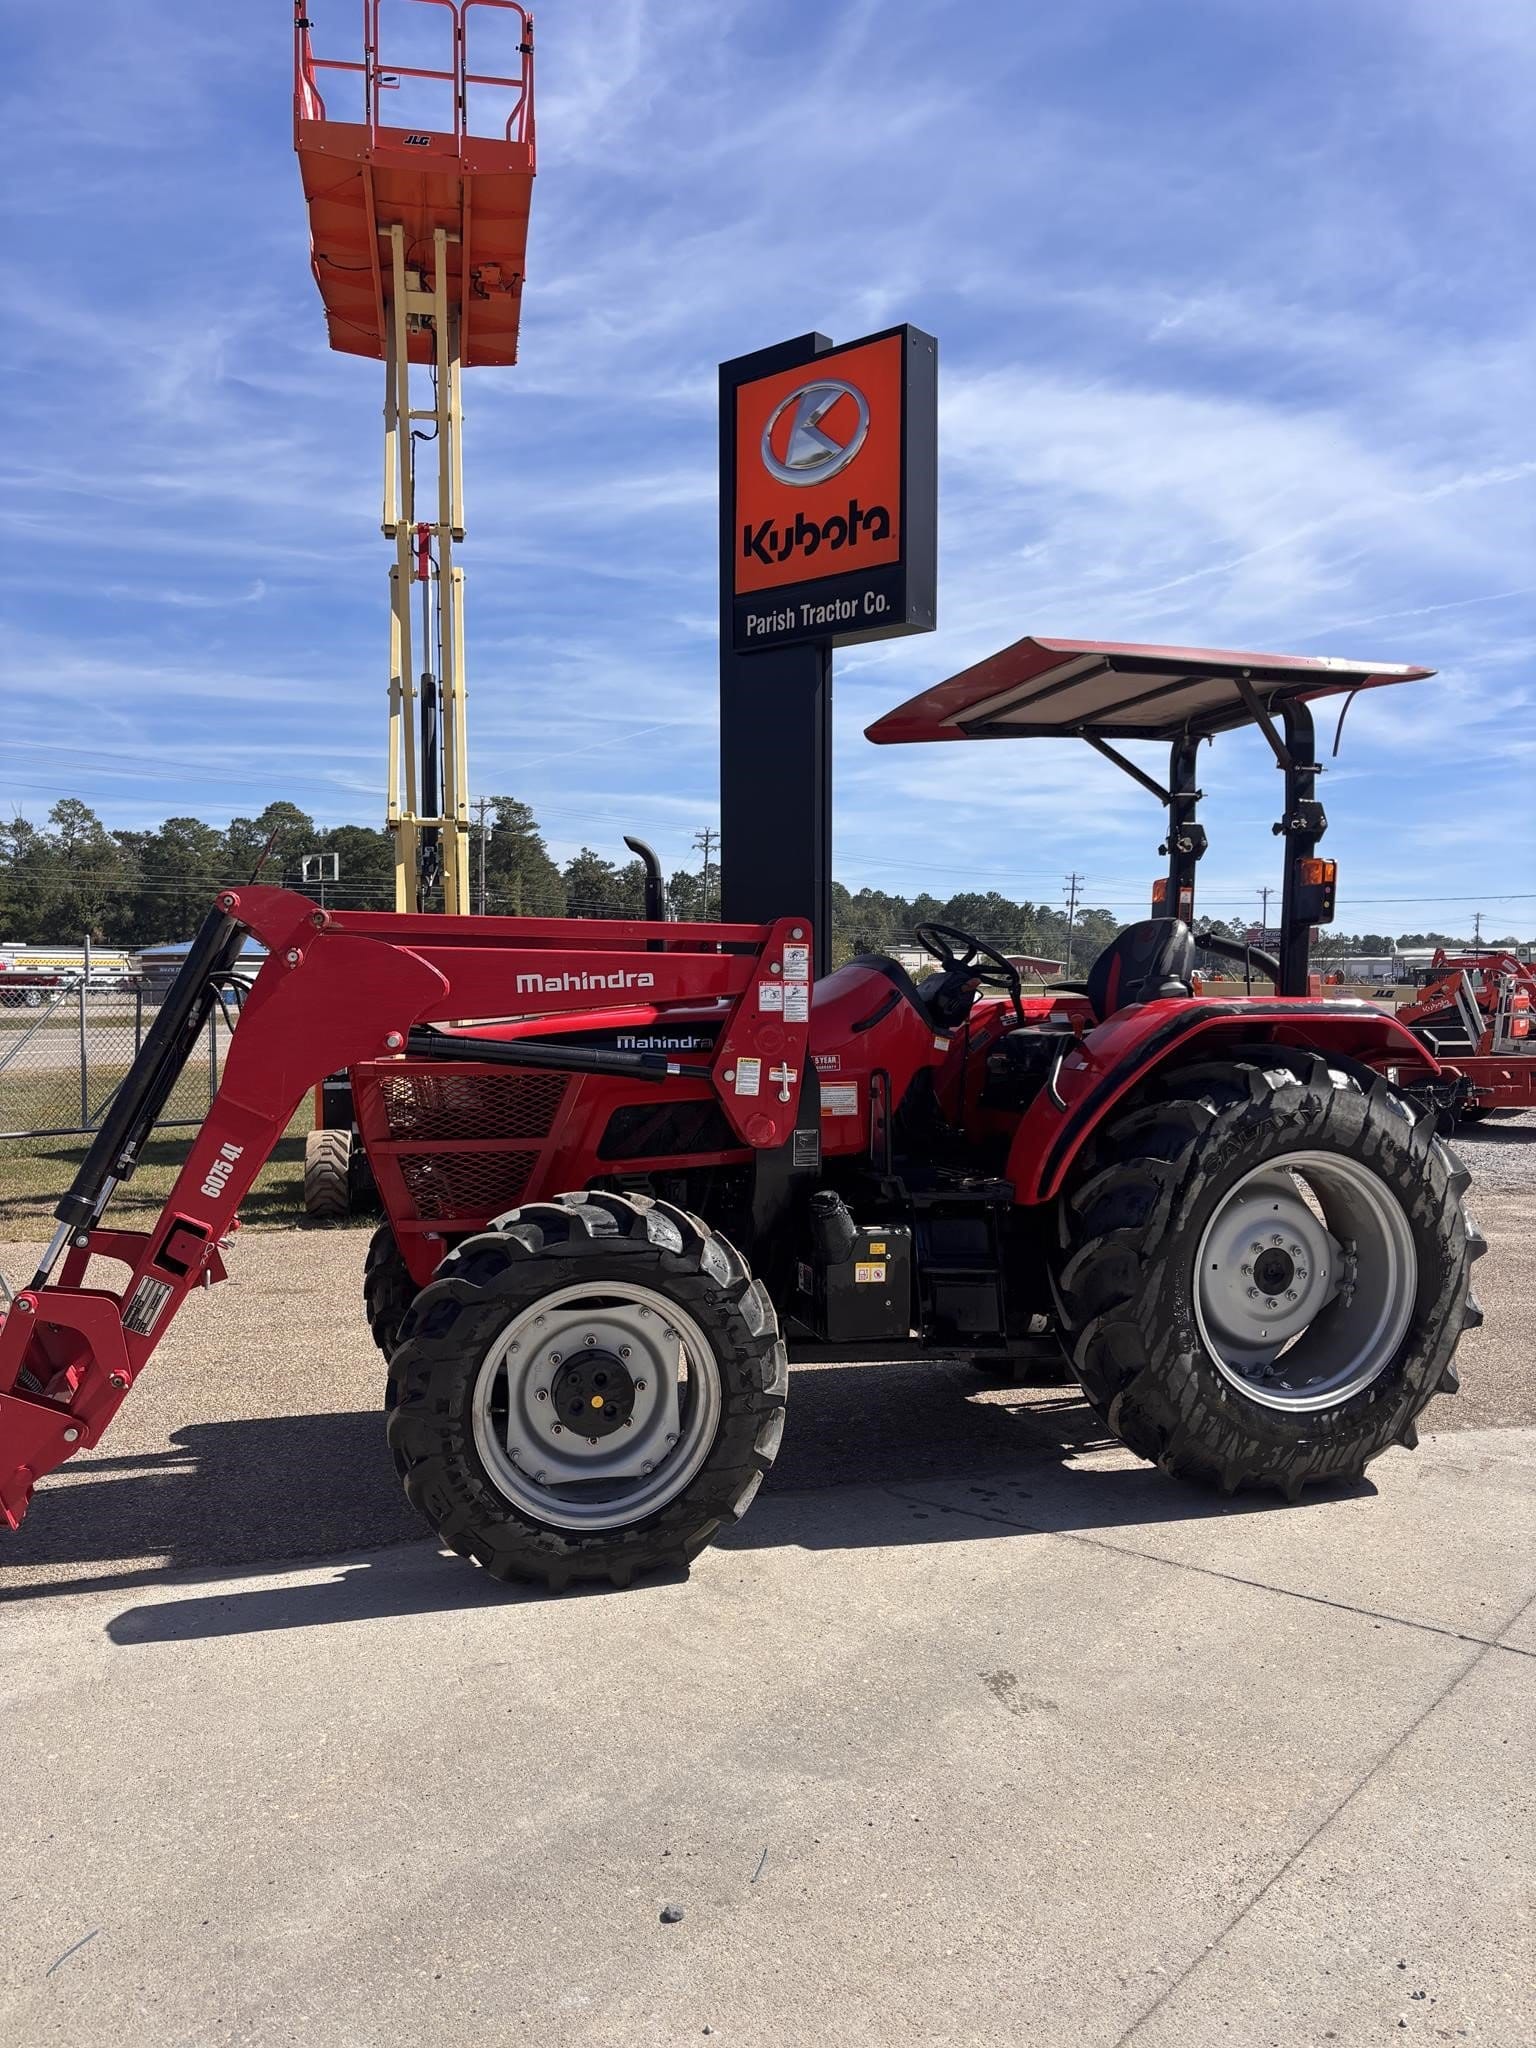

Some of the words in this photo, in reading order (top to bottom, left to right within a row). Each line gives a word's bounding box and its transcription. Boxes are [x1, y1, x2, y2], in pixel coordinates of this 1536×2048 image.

[404, 135, 430, 146] JLG
[743, 499, 890, 564] Kubota
[746, 607, 796, 637] Parish
[800, 597, 859, 627] Tractor
[863, 590, 891, 615] Co.
[516, 969, 654, 994] Mahindra
[1372, 989, 1395, 998] JLG
[616, 1035, 714, 1049] Mahindra
[819, 1056, 837, 1064] YEAR
[200, 1159, 234, 1198] 6075
[220, 1142, 244, 1162] 4L
